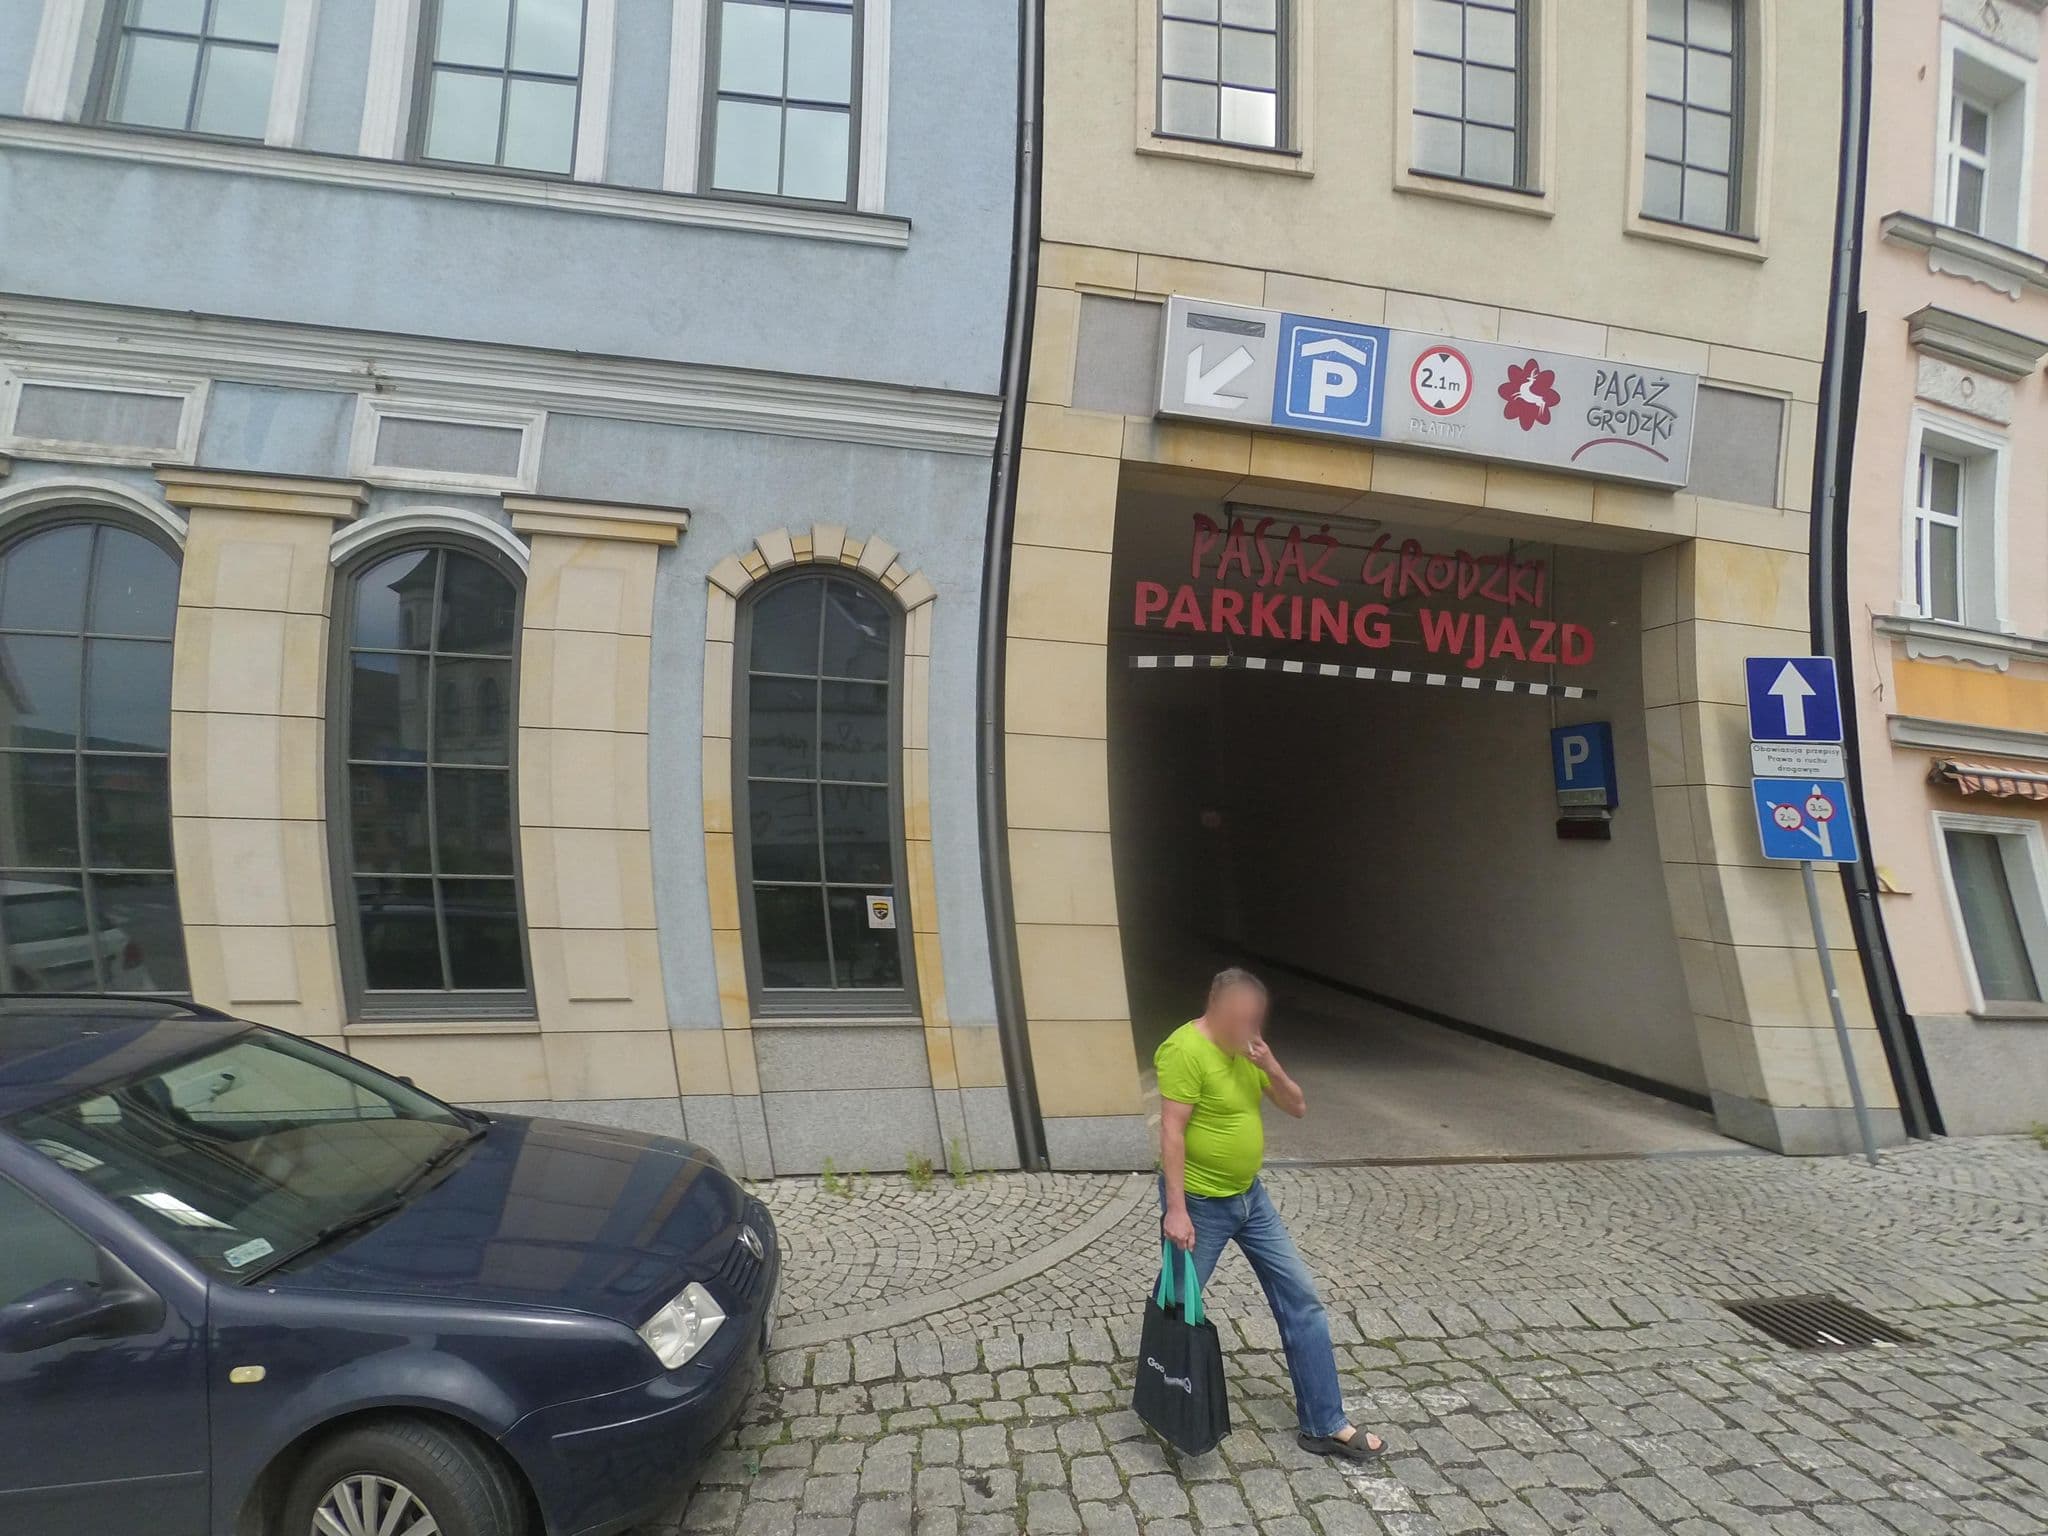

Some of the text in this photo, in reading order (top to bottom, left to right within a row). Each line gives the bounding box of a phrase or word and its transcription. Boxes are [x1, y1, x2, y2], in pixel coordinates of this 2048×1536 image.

[1309, 359, 1358, 414] P
[1421, 367, 1461, 391] 2.1m
[1593, 369, 1678, 419] PASAŻ
[1409, 417, 1467, 438] PŁATNY
[1191, 513, 1546, 608] PASAŻ GRODZKI
[1134, 581, 1596, 669] PARKING WJAZD
[1562, 735, 1590, 781] P
